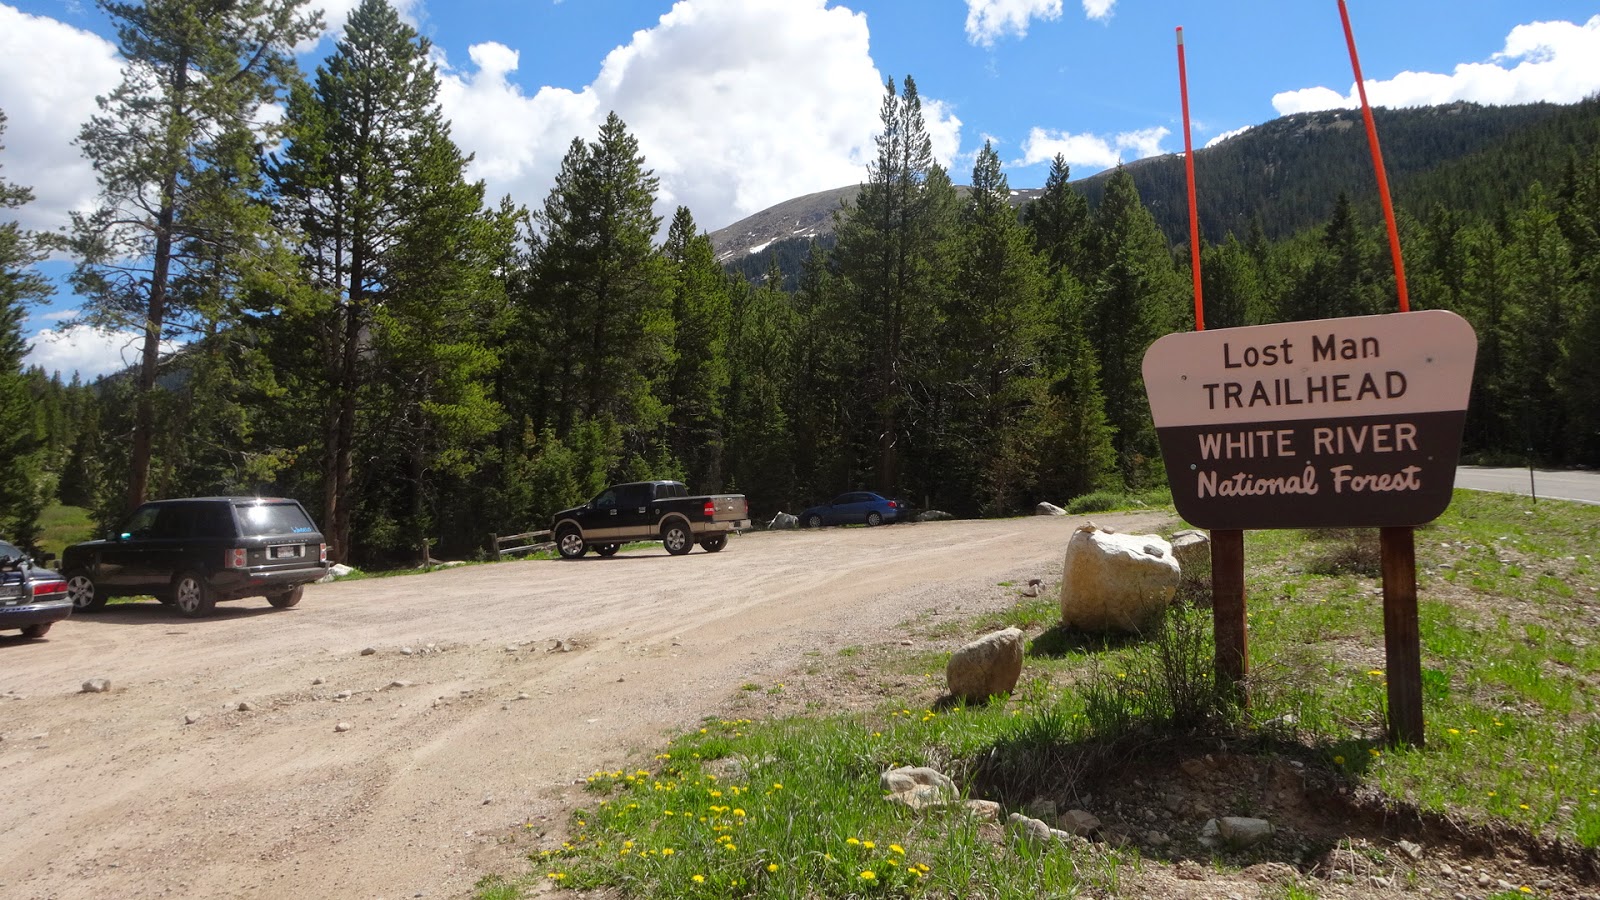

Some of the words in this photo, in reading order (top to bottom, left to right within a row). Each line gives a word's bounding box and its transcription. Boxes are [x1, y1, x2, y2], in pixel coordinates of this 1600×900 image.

[1223, 338, 1294, 369] Lost
[1311, 333, 1380, 363] Man
[1202, 370, 1408, 410] TRAILHEAD
[1198, 429, 1296, 460] WHITE
[1313, 422, 1418, 456] RIVER
[1197, 465, 1319, 499] National
[1329, 464, 1422, 494] Forest
